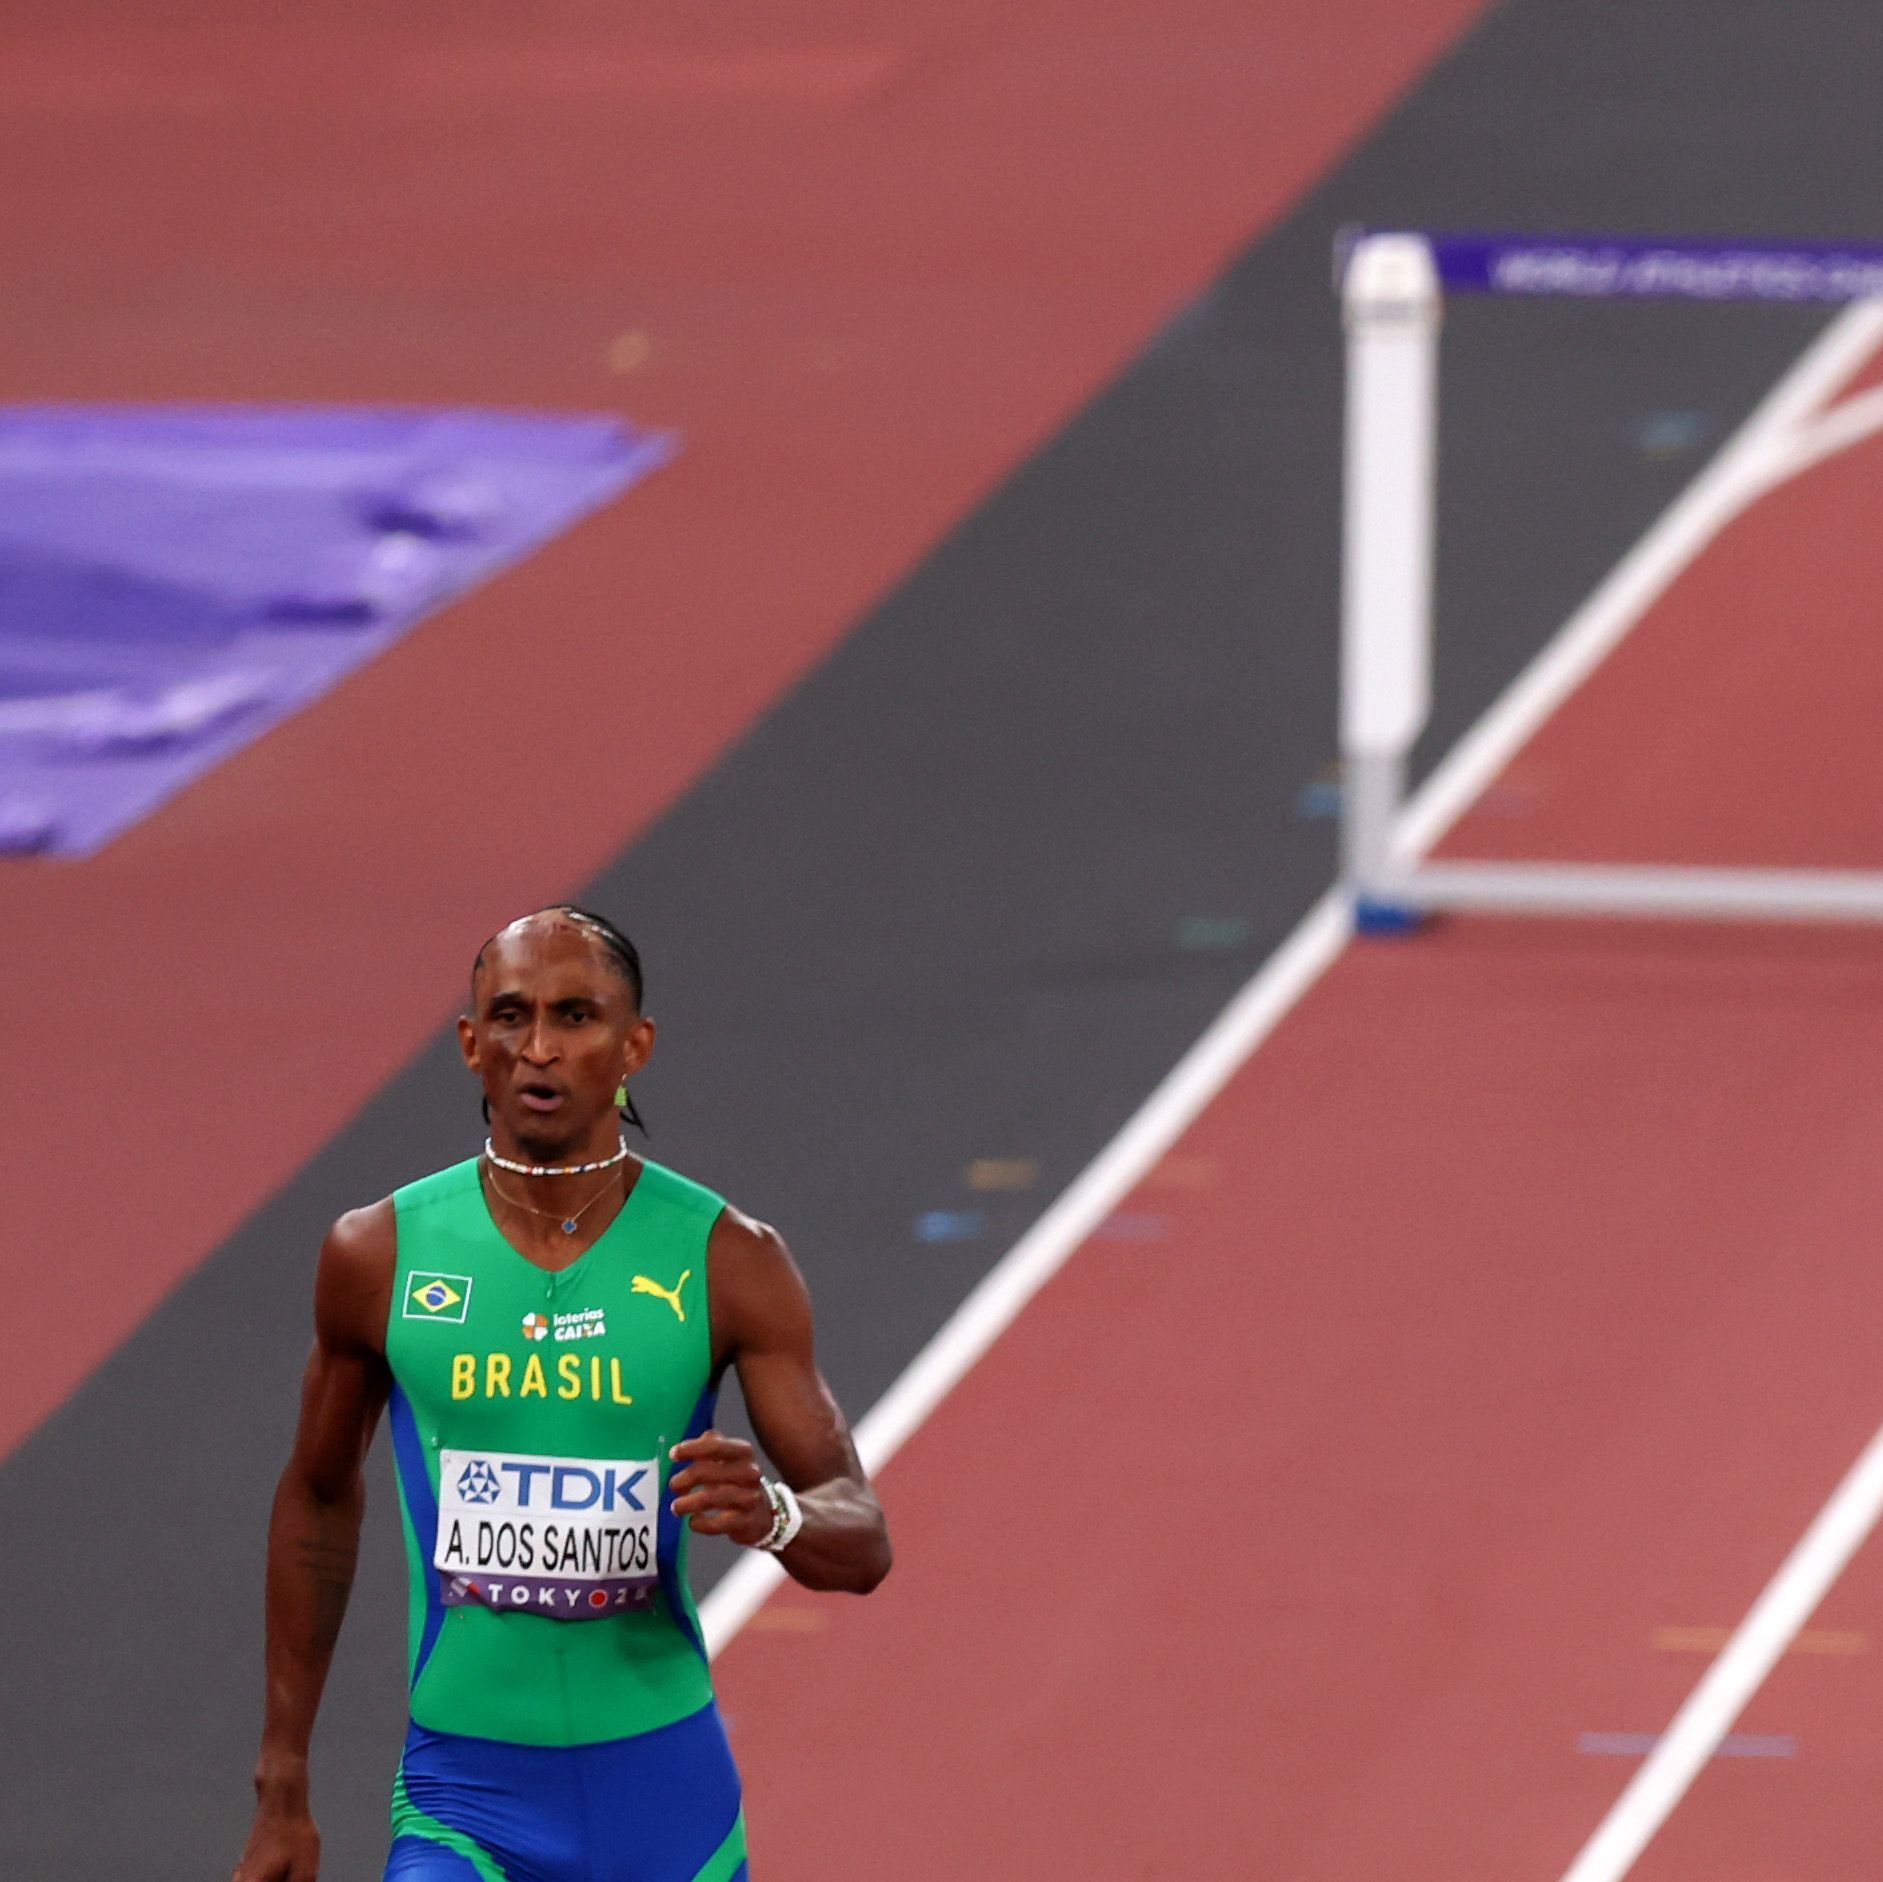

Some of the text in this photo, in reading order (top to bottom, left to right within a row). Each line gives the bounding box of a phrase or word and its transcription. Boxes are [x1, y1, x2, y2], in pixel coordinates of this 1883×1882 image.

[452, 1353, 632, 1405] BRASIL
[501, 1462, 650, 1513] TDK
[445, 1519, 650, 1574] A. DOS SANTOS
